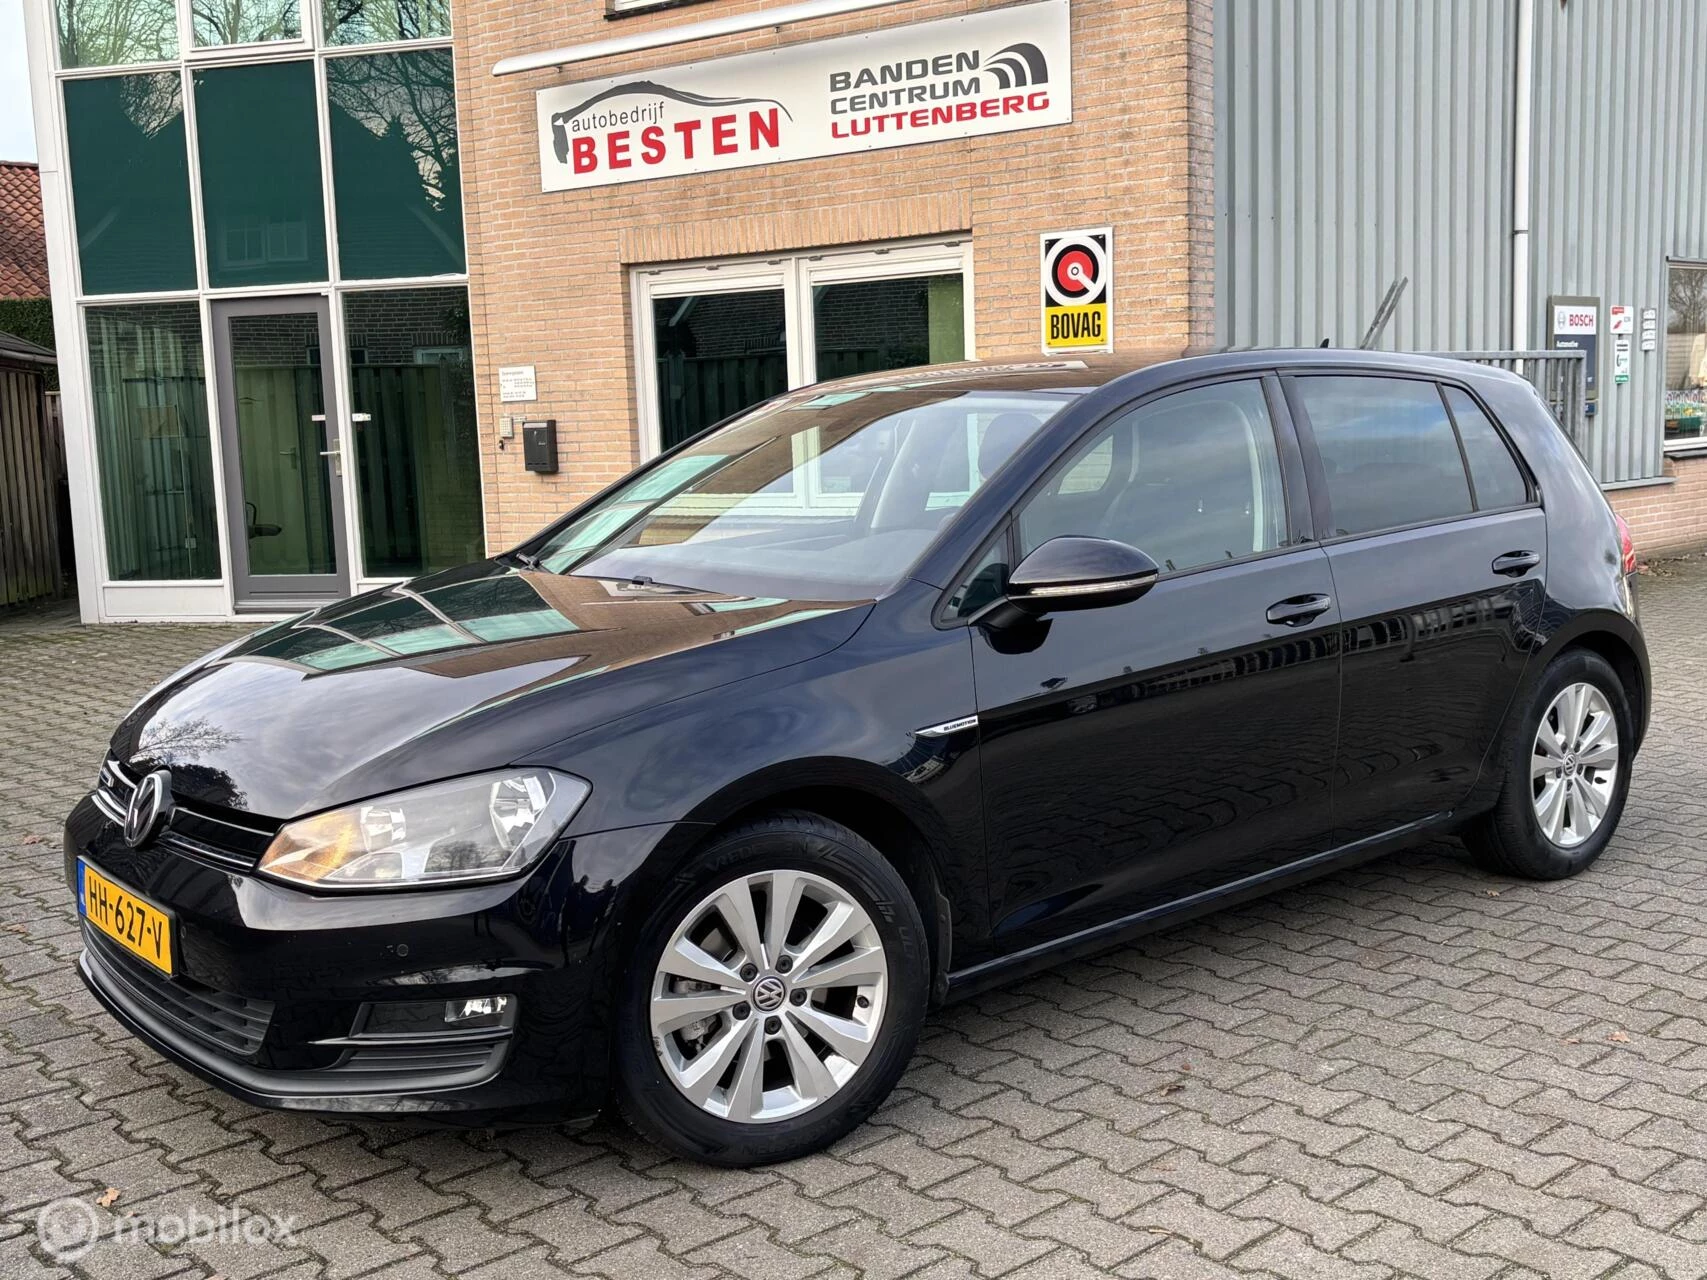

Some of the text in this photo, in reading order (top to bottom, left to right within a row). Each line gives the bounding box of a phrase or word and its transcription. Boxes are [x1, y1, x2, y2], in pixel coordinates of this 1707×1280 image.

[829, 49, 980, 93] BANDEN
[830, 76, 980, 116] CENTRUM
[831, 91, 1050, 139] LUTTENBERG
[571, 101, 665, 133] autobedrijf
[573, 107, 781, 175] BESTEN
[1050, 310, 1102, 340] BOVAG
[1568, 314, 1594, 327] BOSCH
[943, 719, 977, 732] BLUEMOTION
[88, 875, 163, 960] HH-627-V
